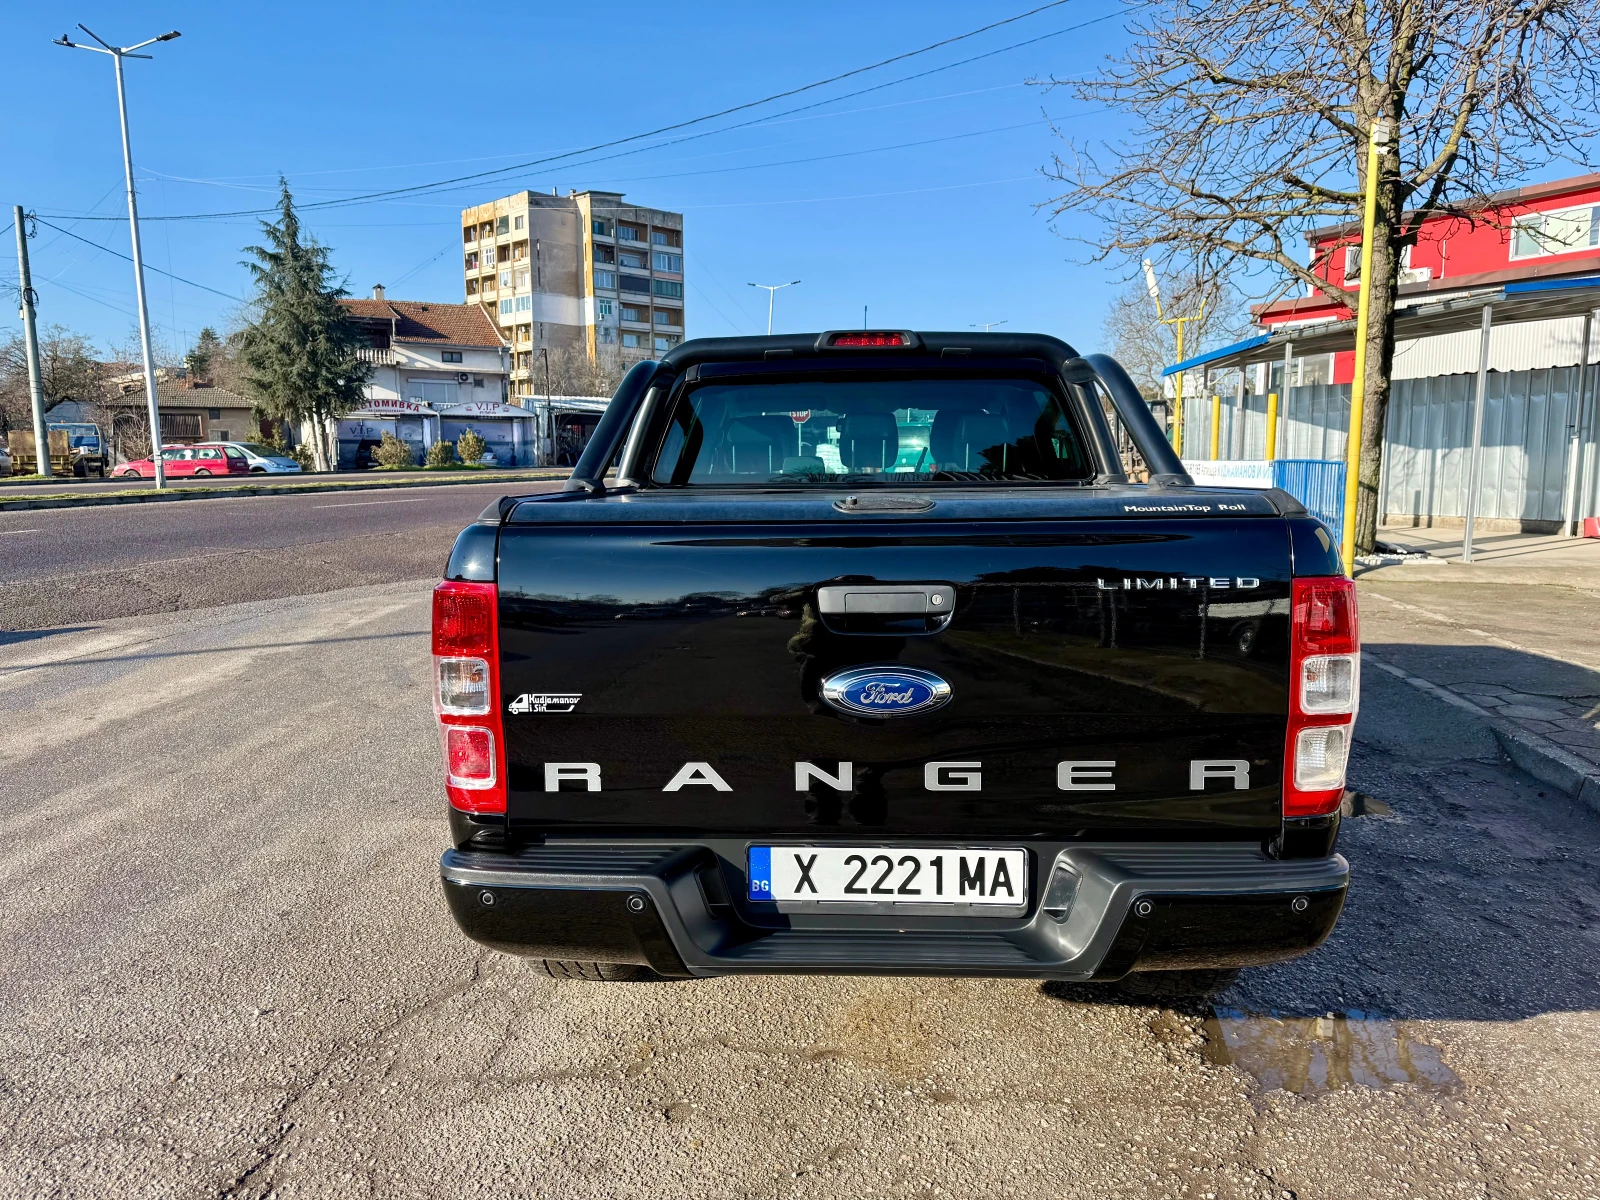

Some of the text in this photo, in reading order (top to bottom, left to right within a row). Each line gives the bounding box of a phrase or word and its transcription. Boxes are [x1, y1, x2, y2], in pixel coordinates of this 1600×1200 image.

[1124, 503, 1246, 513] MountainTop Roll
[1097, 577, 1260, 590] LIMITED
[860, 681, 914, 704] Ford
[529, 693, 580, 706] Kudjamanov
[544, 759, 1250, 792] RANGER
[793, 853, 1015, 897] X 2221 MA
[751, 879, 769, 892] BG
